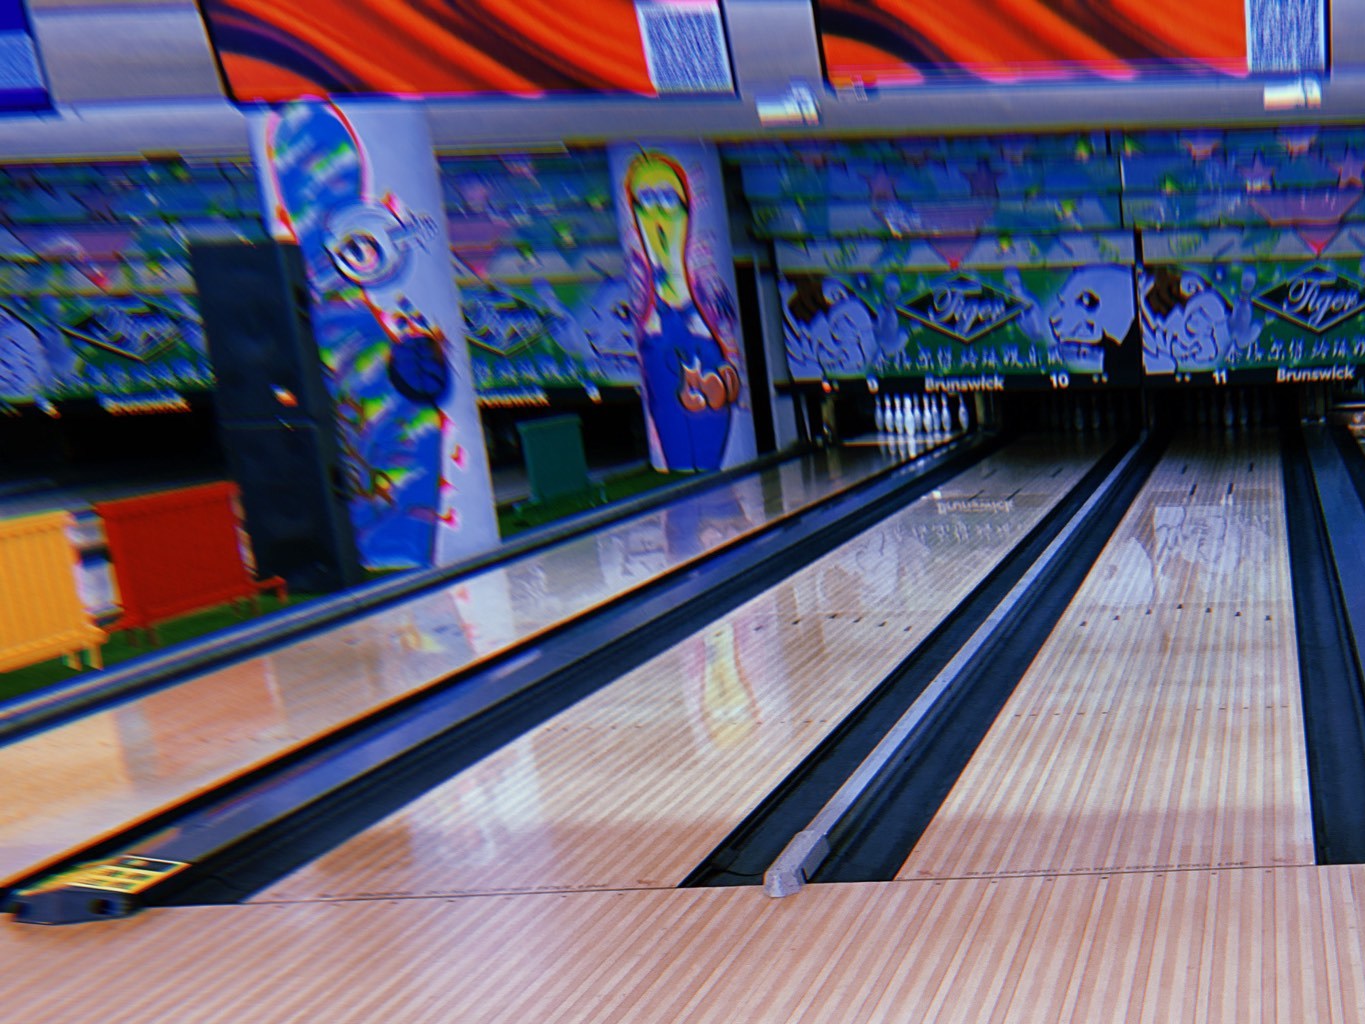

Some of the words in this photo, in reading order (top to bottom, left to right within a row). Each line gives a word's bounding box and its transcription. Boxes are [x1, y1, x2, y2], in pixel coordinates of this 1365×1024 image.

[928, 280, 1006, 333] Tiger
[1281, 270, 1360, 327] Tiger
[924, 373, 1005, 392] Brunswick
[1050, 370, 1070, 389] 10
[1212, 369, 1228, 384] 11
[1276, 364, 1356, 383] Brunswick
